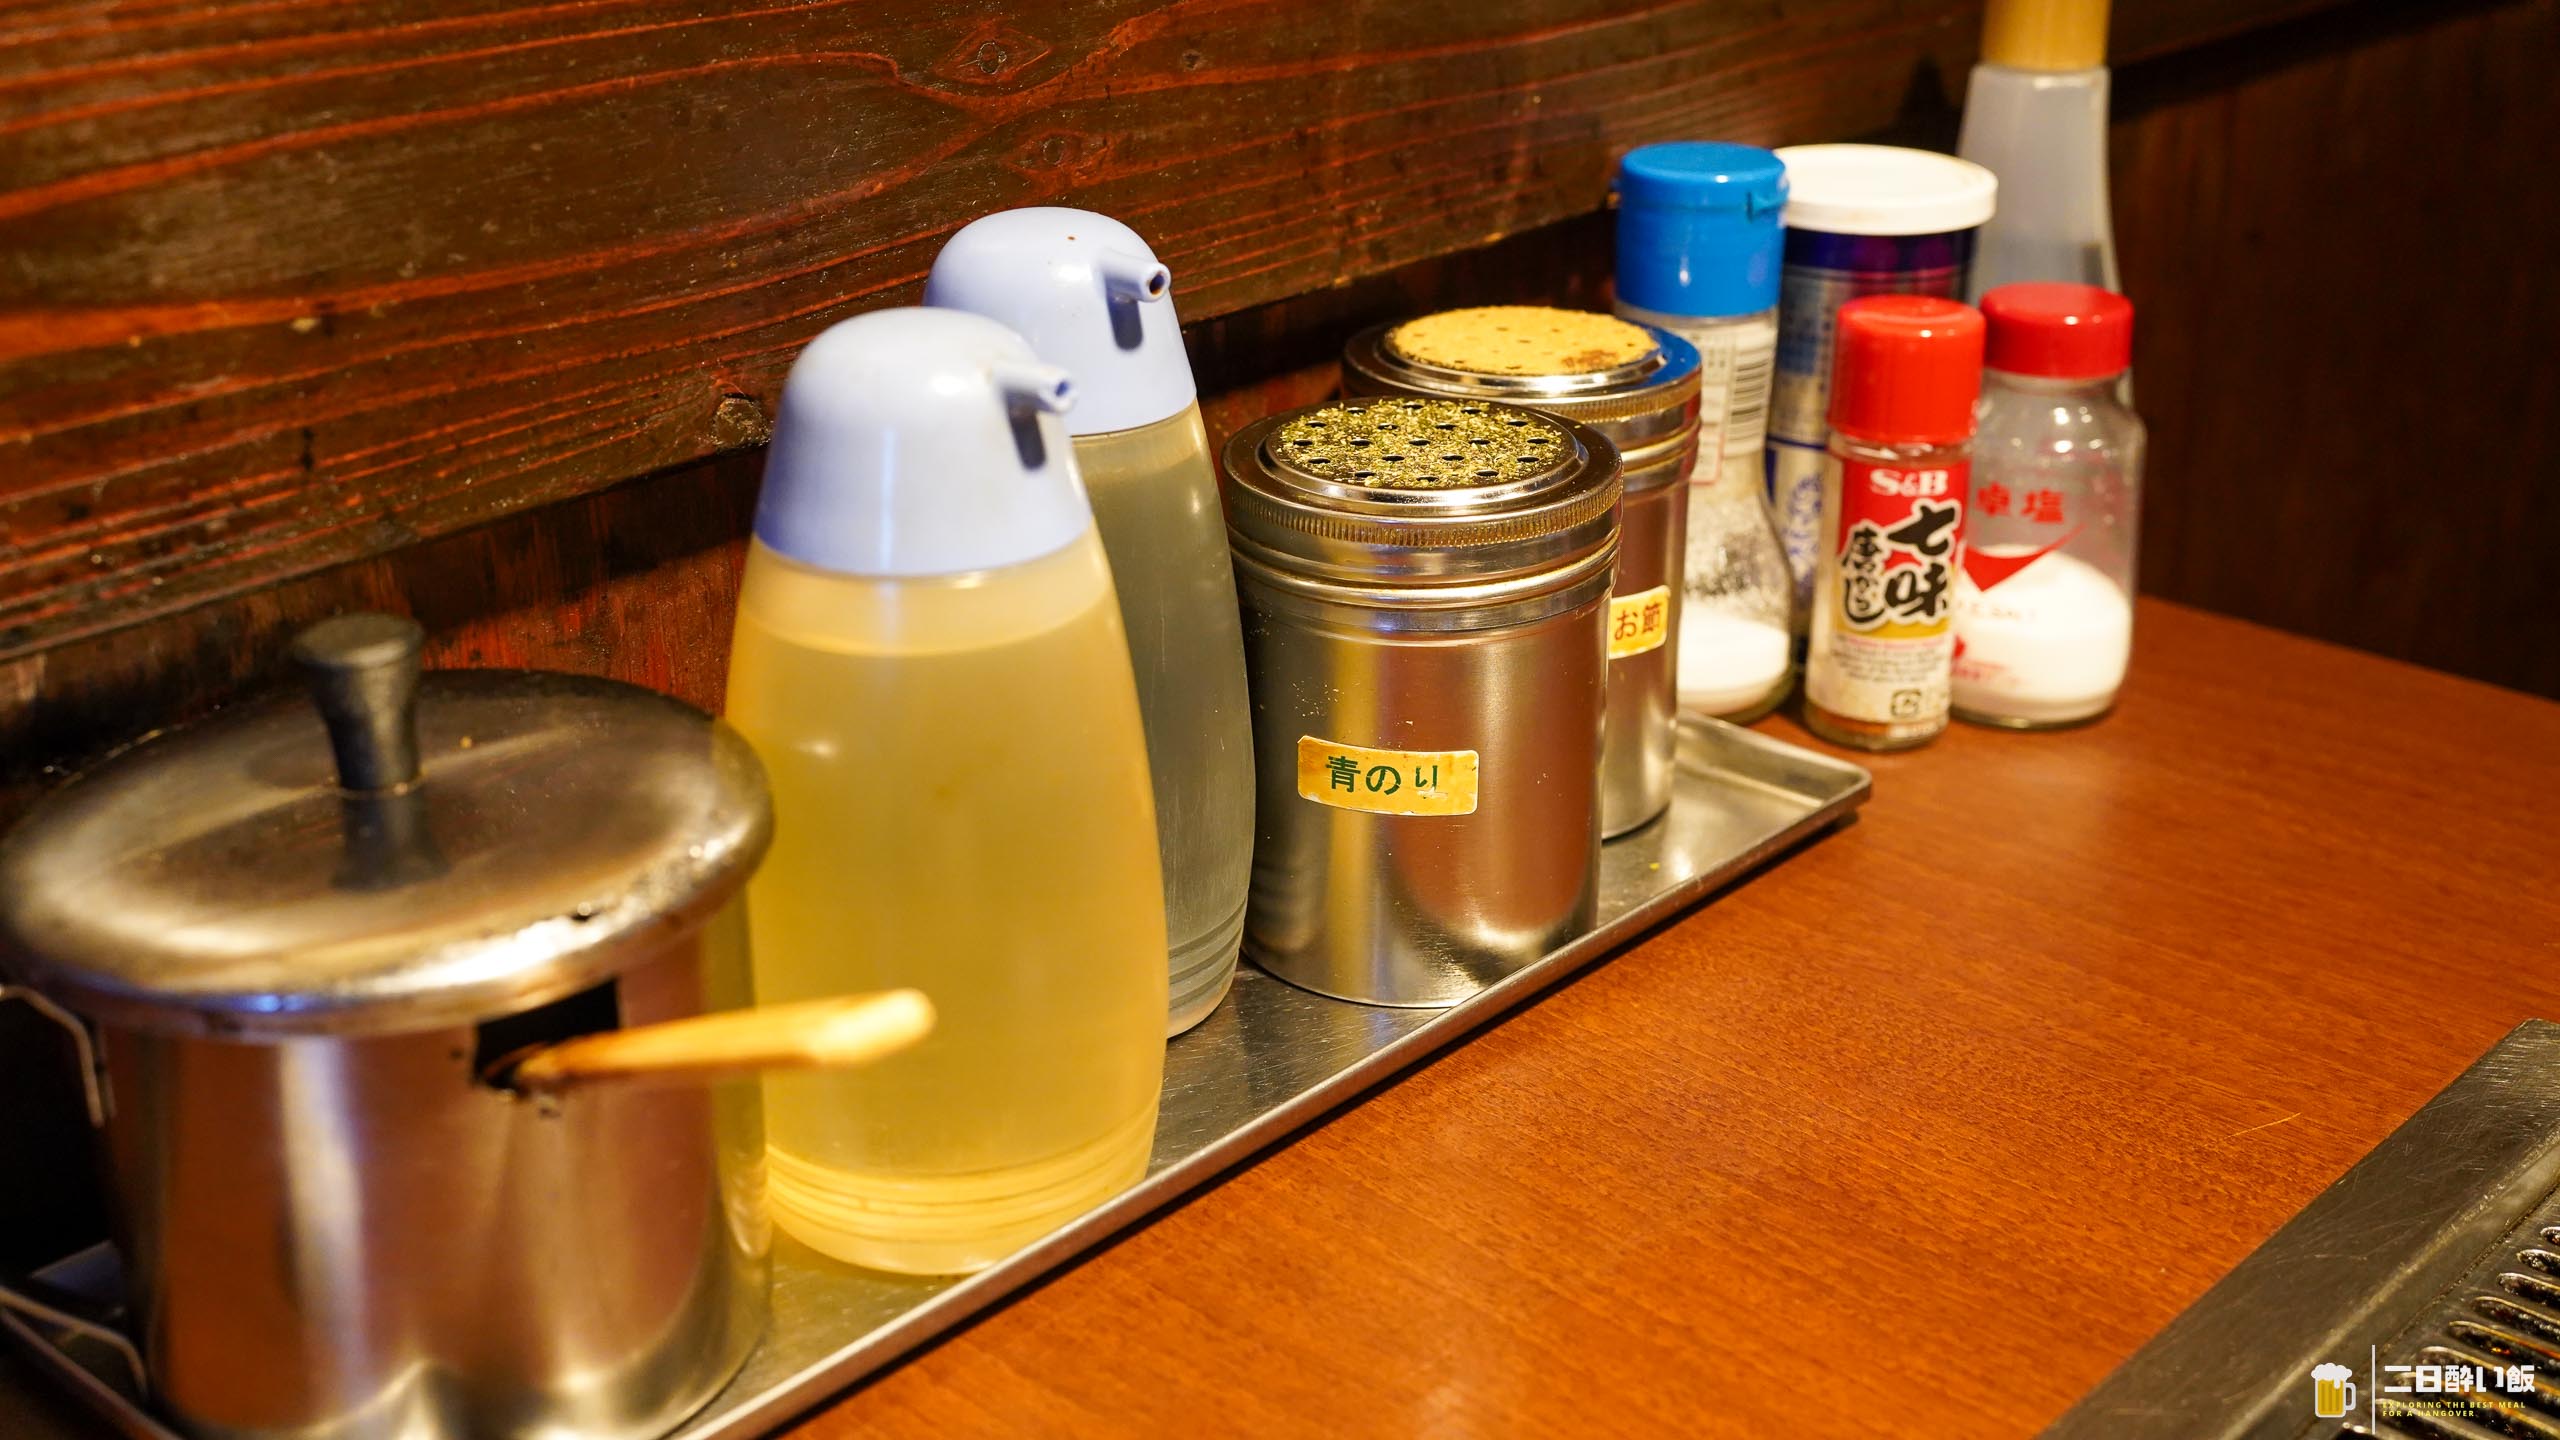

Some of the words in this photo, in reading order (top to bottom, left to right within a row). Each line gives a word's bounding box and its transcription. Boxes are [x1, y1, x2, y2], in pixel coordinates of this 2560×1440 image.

[1870, 468, 1949, 497] S&B
[1885, 504, 1956, 618] 七味
[1614, 601, 1663, 641] お節
[1325, 755, 1438, 799] 青のり
